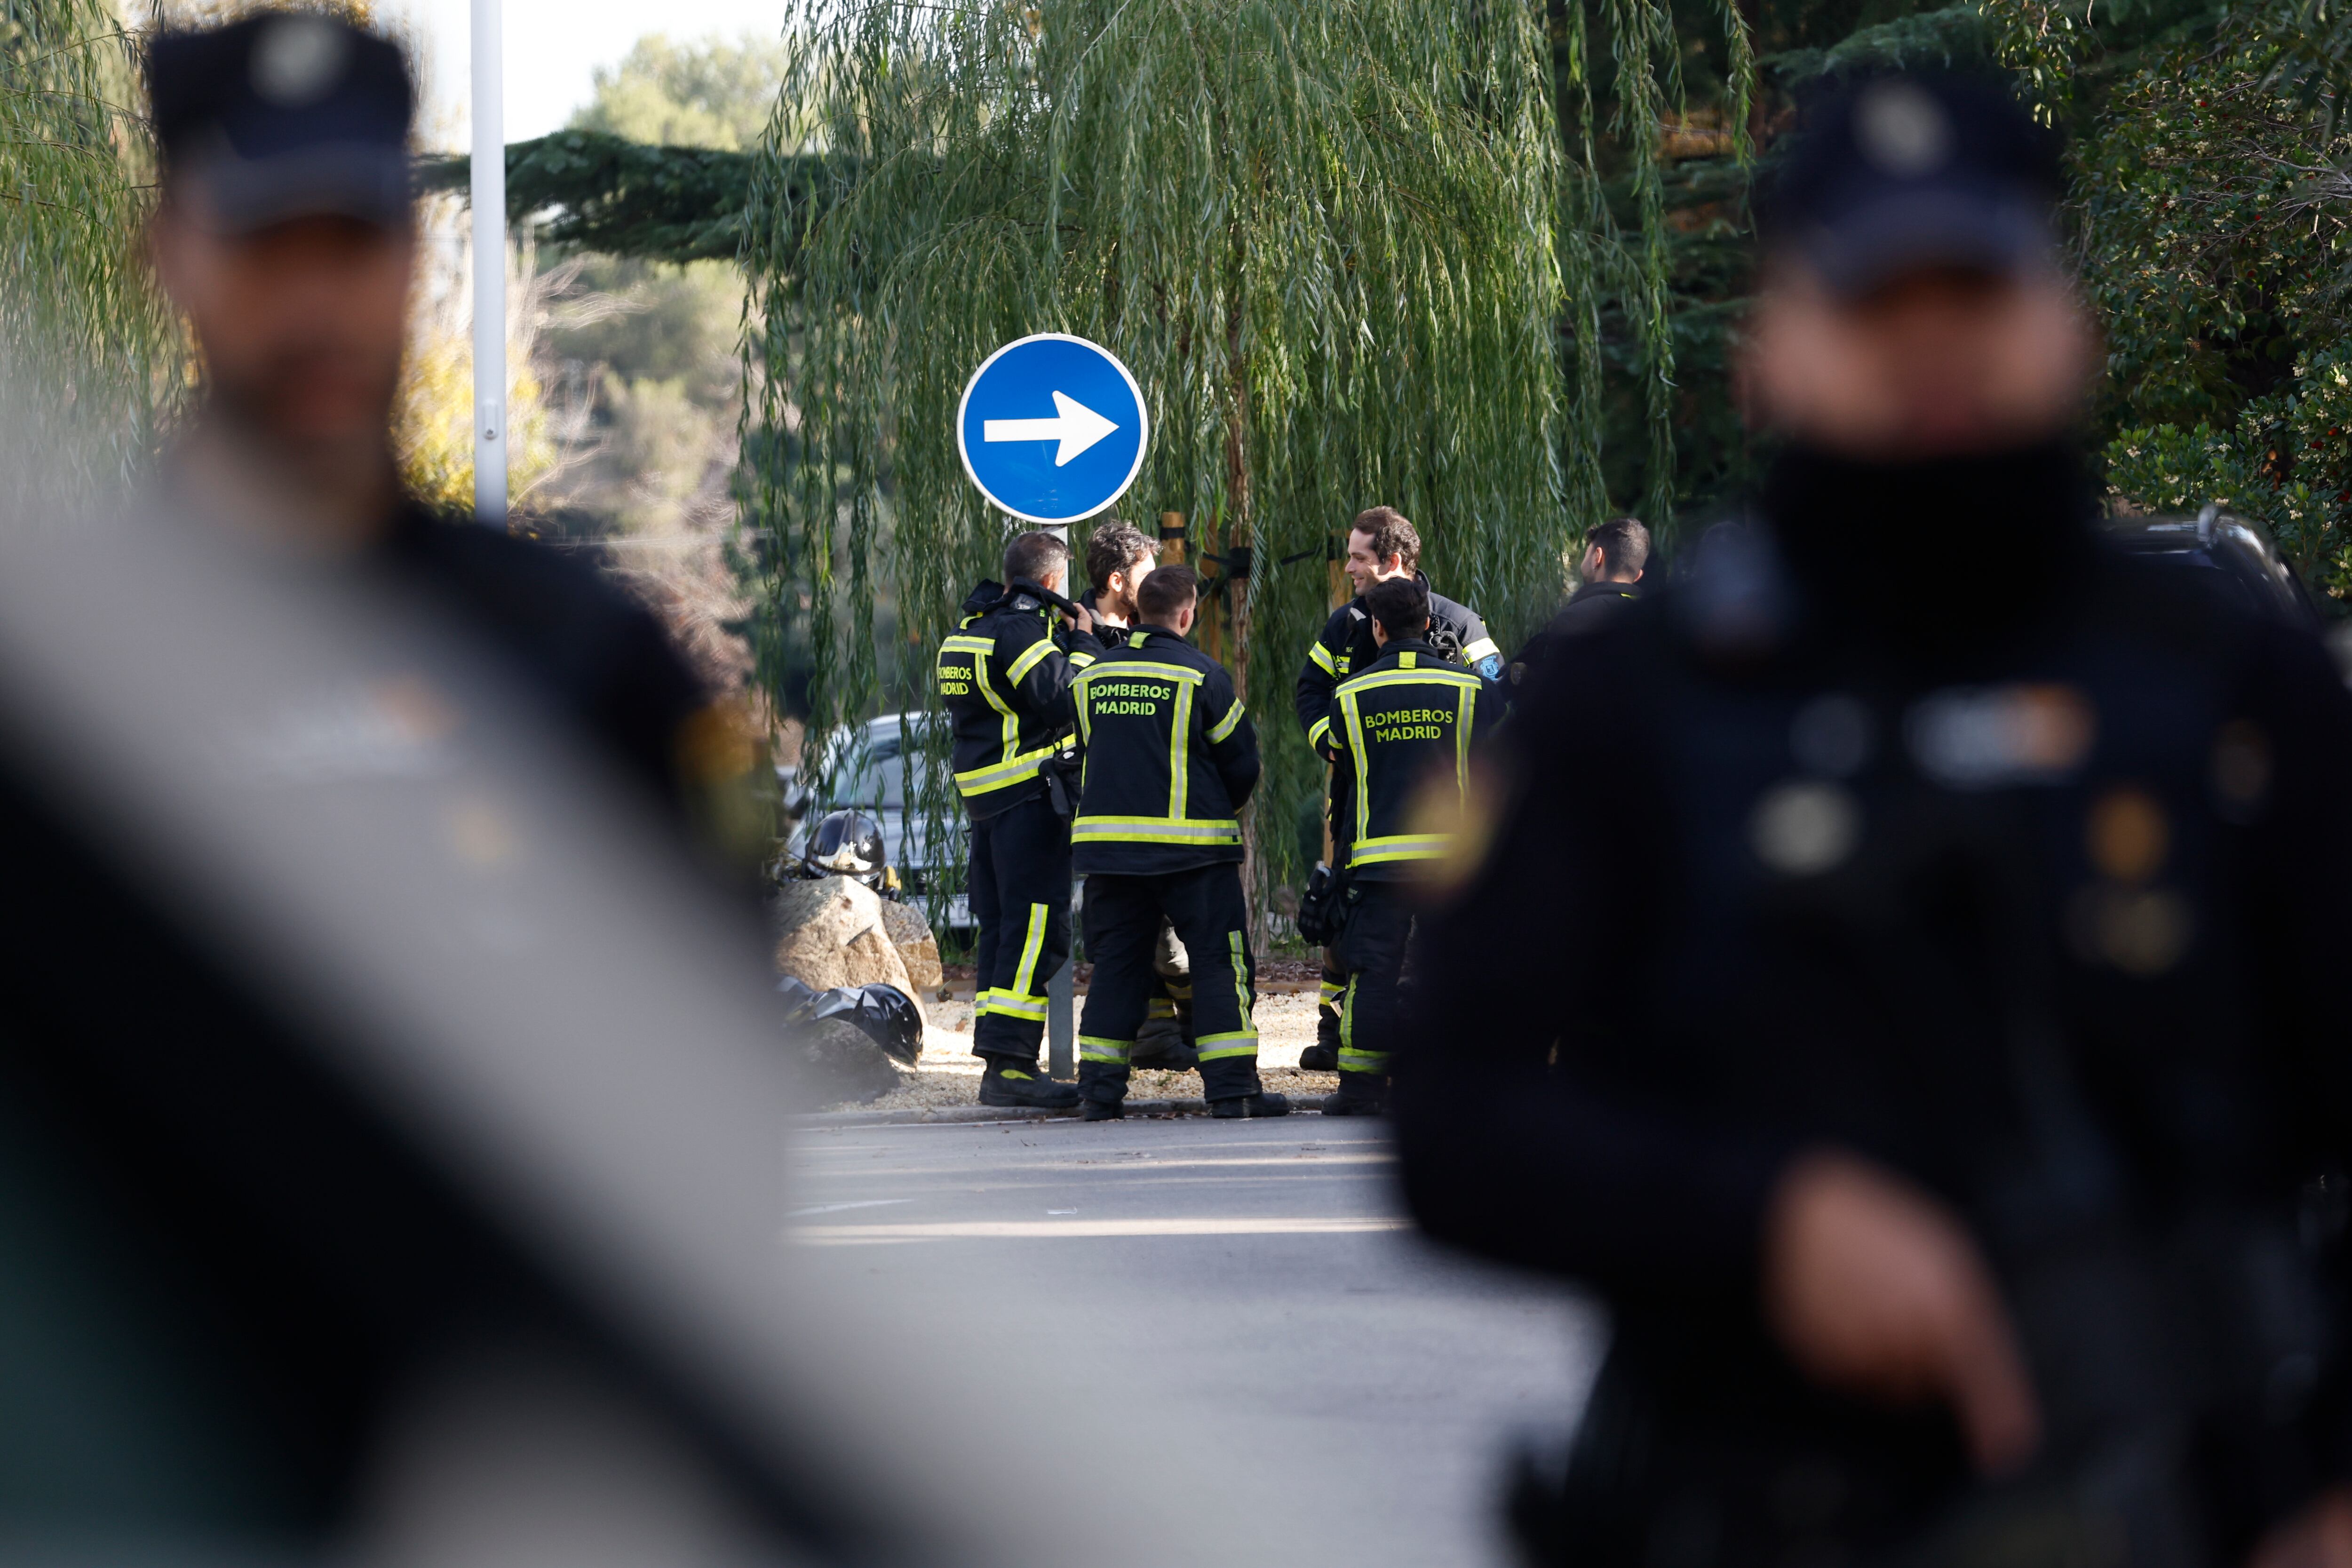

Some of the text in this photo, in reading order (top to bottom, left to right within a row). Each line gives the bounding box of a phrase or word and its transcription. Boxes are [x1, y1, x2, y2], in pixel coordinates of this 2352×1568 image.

[1090, 684, 1171, 700] BOMBEROS
[1095, 701, 1156, 715] MADRID
[1365, 709, 1454, 729] BOMBEROS
[1375, 725, 1442, 742] MADRID
